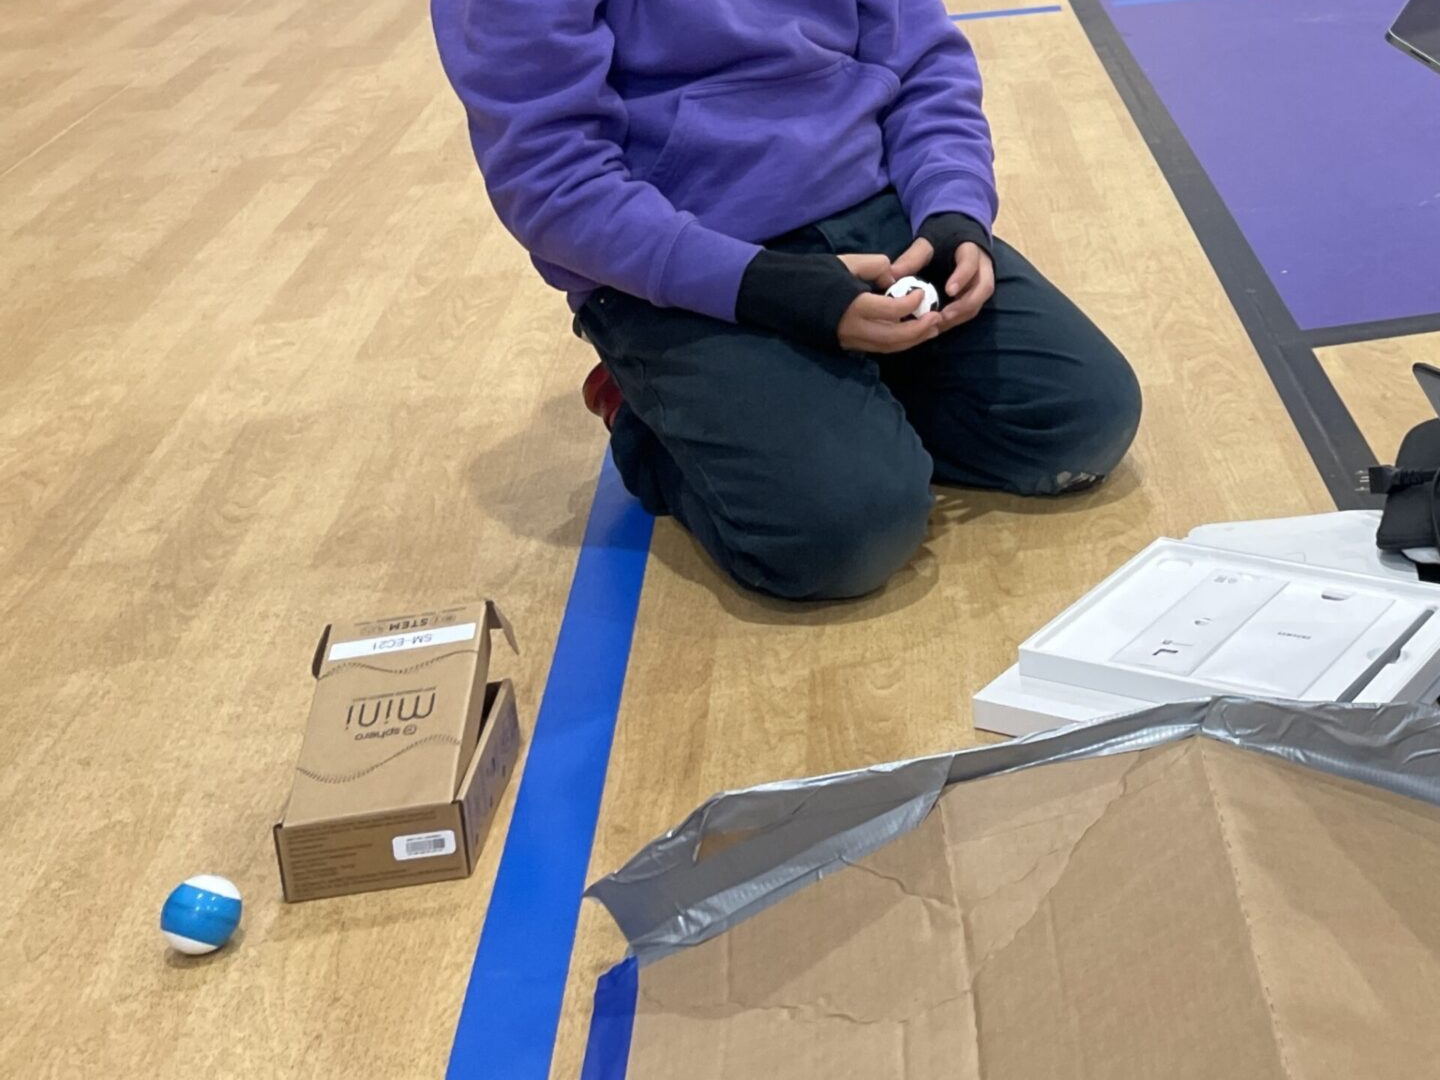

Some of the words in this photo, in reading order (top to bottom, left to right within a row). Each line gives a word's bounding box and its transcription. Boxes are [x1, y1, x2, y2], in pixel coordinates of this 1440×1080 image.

[389, 617, 429, 631] STEM
[372, 633, 433, 650] SM-EC21
[344, 692, 436, 730] mini
[354, 727, 401, 741] sphero
